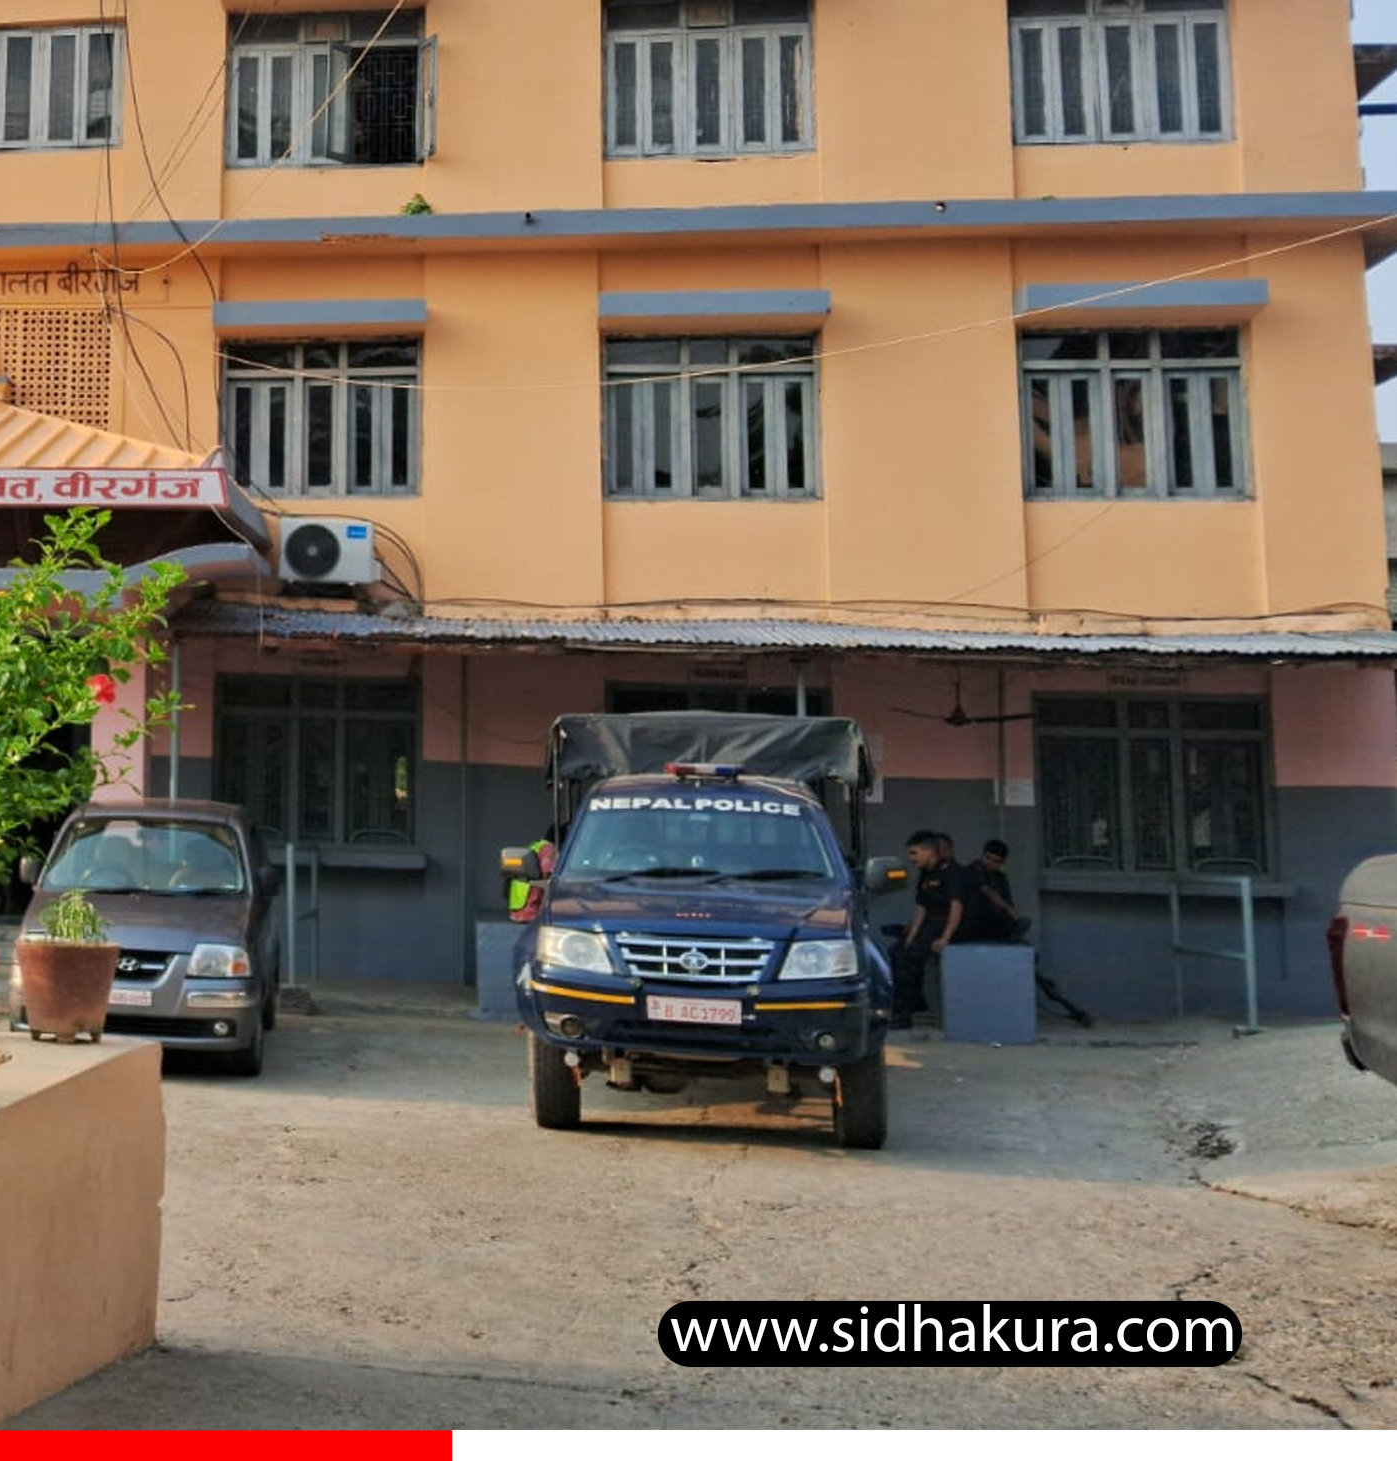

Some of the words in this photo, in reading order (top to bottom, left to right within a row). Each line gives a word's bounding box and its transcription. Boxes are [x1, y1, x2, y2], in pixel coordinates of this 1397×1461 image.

[53, 471, 201, 499] वीरगंज
[589, 797, 692, 812] NEPAL
[694, 798, 802, 817] POLICE
